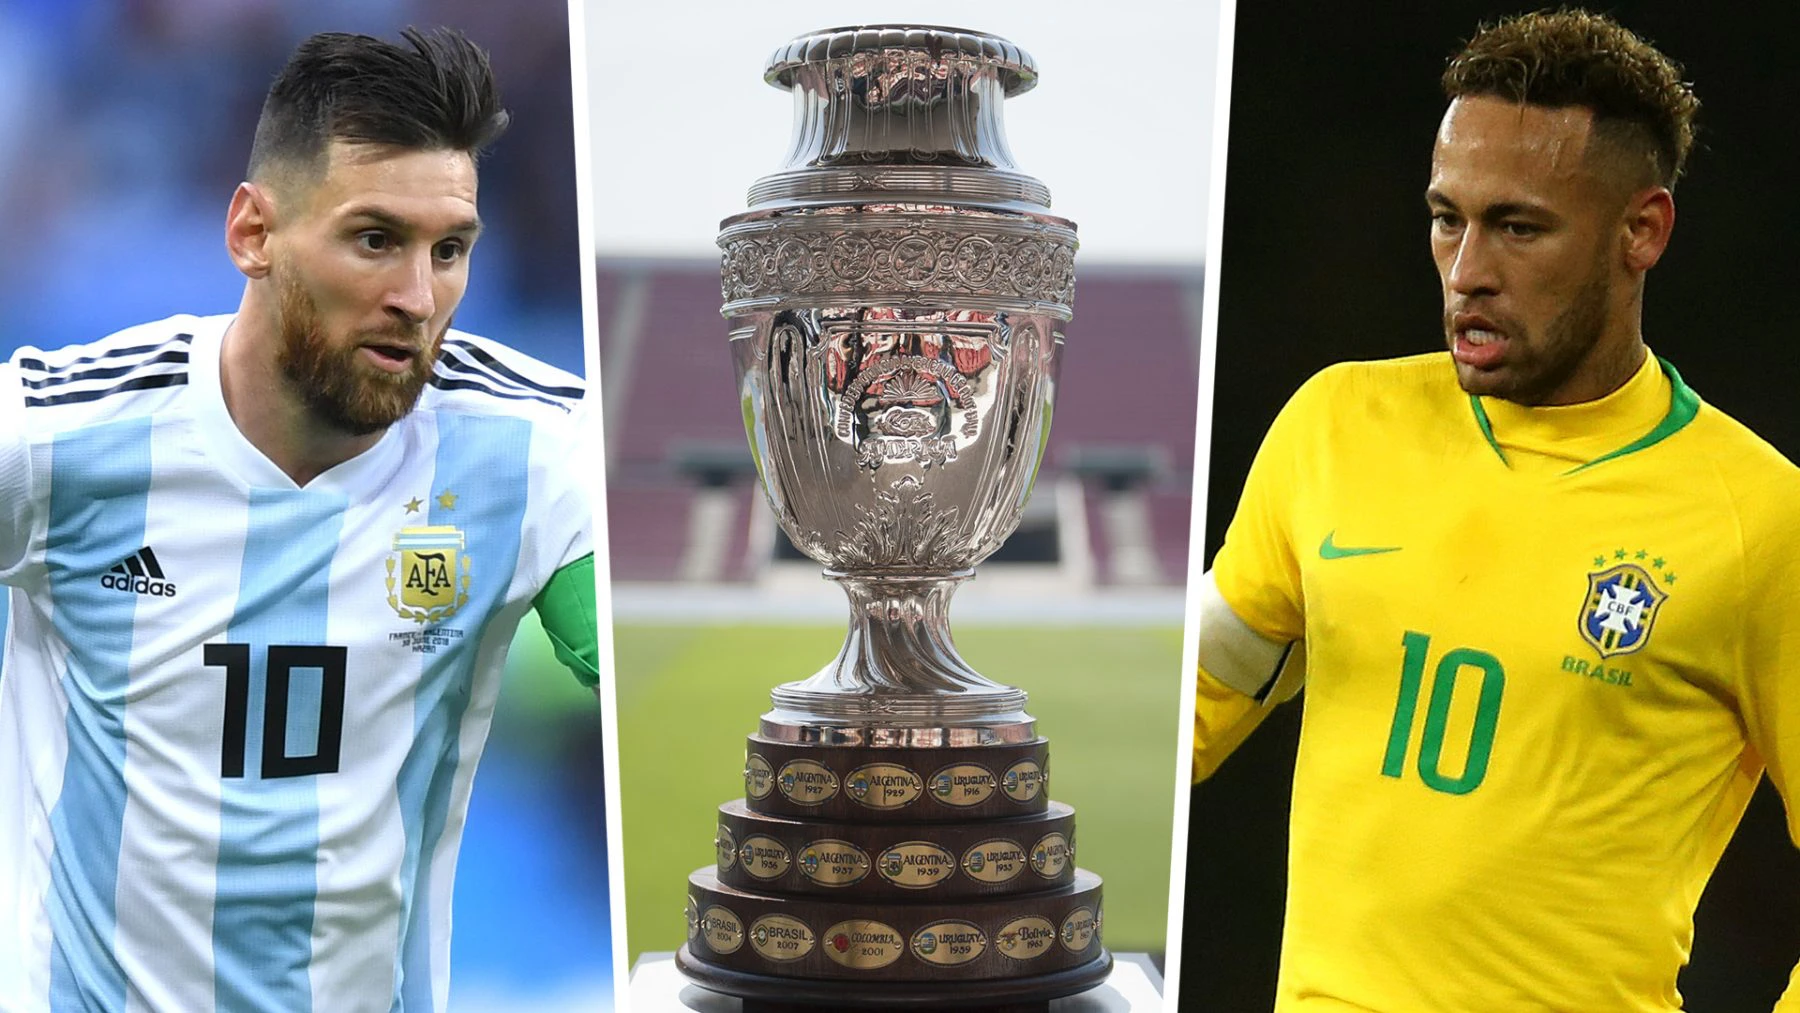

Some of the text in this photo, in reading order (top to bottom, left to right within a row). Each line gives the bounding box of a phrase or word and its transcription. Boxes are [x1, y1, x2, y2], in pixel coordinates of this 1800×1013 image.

[405, 552, 451, 596] AFA
[101, 573, 176, 598] adidas
[1607, 601, 1634, 616] CBF
[1561, 655, 1633, 687] BRASIL
[203, 643, 348, 779] 10
[1381, 630, 1506, 796] 10
[795, 772, 832, 784] ARGENTINA
[870, 775, 914, 787] ARGENTINA
[954, 774, 991, 786] URUGUAY
[805, 785, 823, 795] 1927
[883, 788, 905, 797] 1929
[964, 787, 980, 796] 1916
[820, 852, 863, 864] ARGENTINA
[903, 854, 948, 866] ARGENTINA
[987, 851, 1021, 862] URUGUAY
[712, 917, 738, 932] BRASIL
[769, 927, 808, 941] BRASIL
[852, 932, 894, 944] COLOMBIA
[939, 933, 980, 944] URUGUAY
[1018, 926, 1051, 941] Bolivia
[777, 941, 799, 950] 2007
[862, 947, 884, 956] 2001
